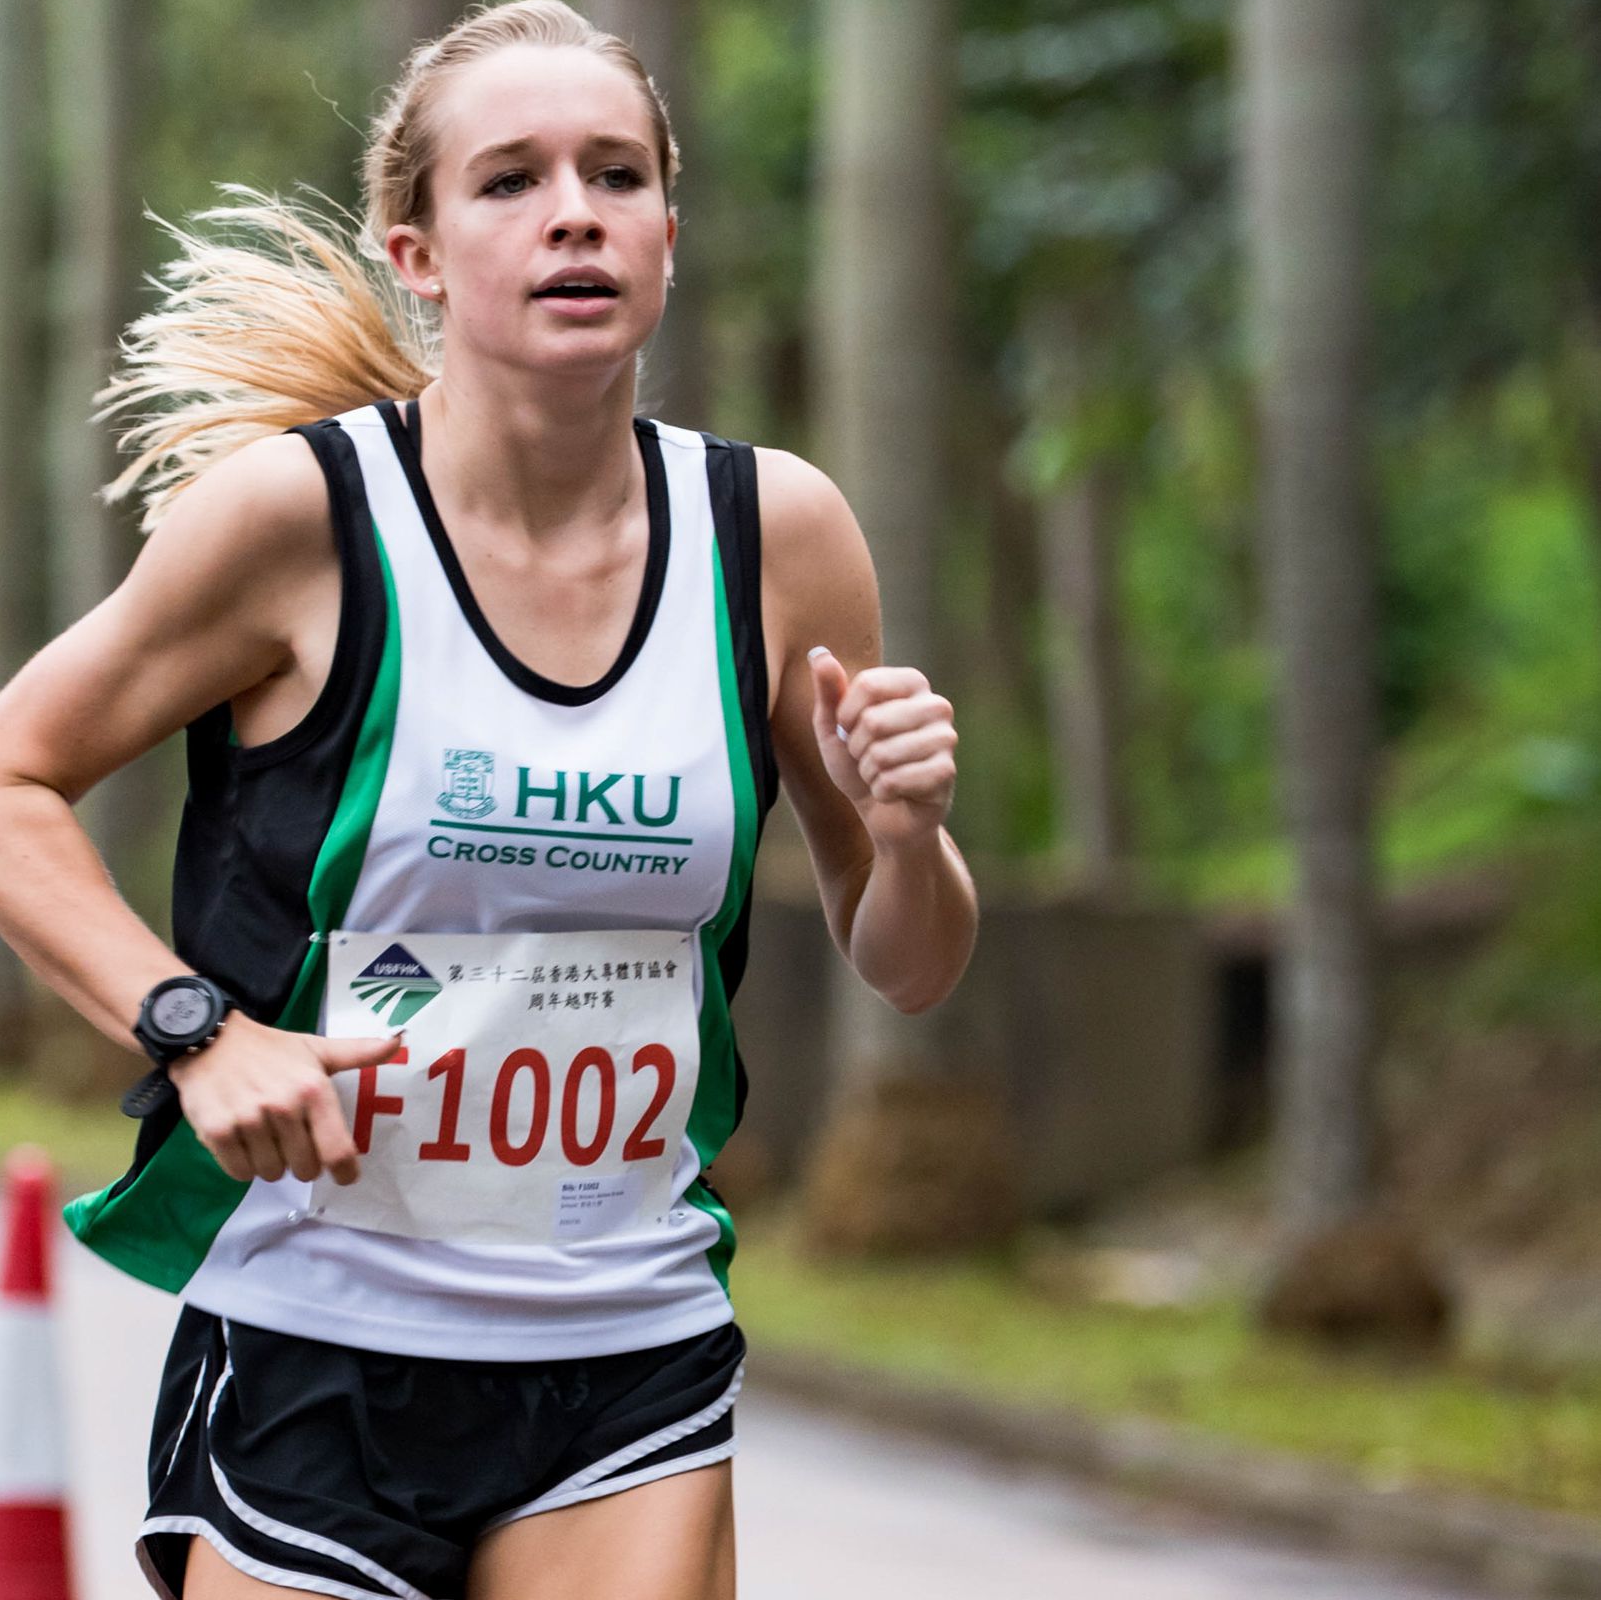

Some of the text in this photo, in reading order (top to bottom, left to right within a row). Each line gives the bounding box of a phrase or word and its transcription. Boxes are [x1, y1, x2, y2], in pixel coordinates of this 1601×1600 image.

[514, 766, 682, 828] HKU
[427, 835, 689, 876] CROSS COUNTRY
[352, 1043, 676, 1166] F1002
